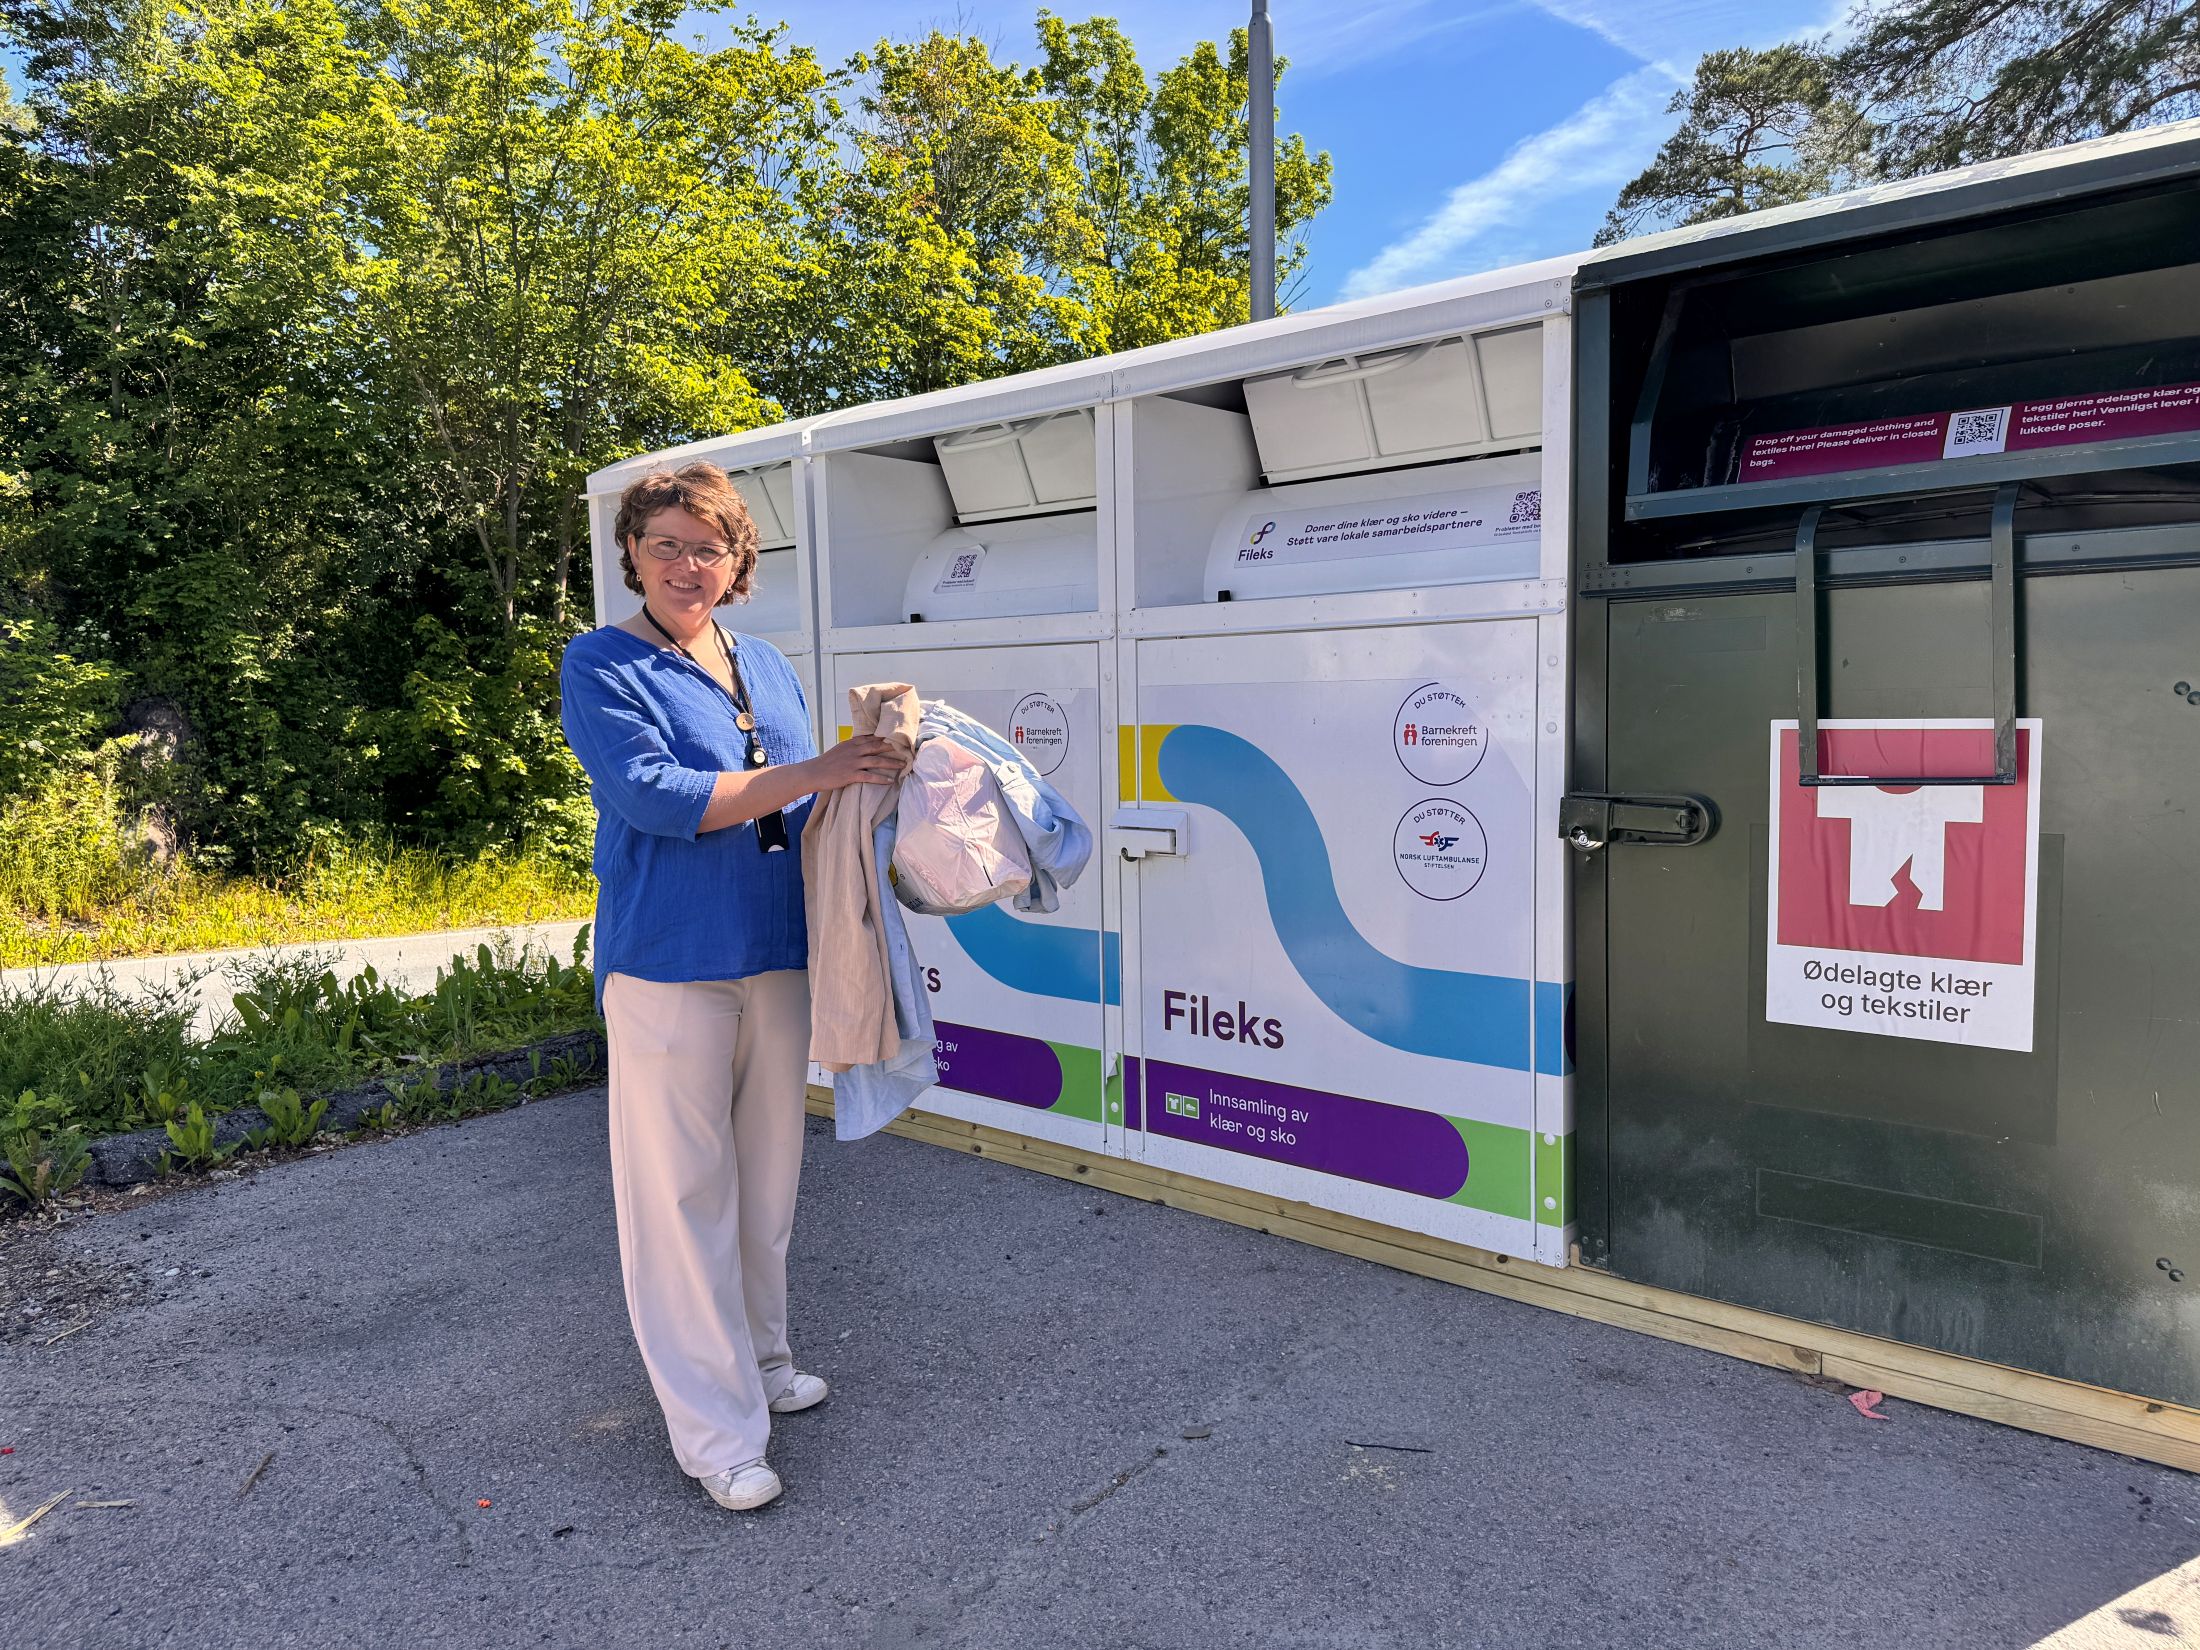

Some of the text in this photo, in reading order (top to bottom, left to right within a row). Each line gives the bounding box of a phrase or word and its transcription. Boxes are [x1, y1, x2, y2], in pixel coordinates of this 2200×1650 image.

[2056, 399, 2094, 410] gjerne
[2096, 392, 2150, 403] ødelagte
[2153, 388, 2182, 398] klær
[2022, 396, 2200, 423] tekstiler her! Vennligst lever i
[1780, 435, 1794, 444] off
[1795, 434, 1818, 443] your
[1820, 427, 1867, 439] damaged
[1870, 422, 1912, 432] clothing
[1914, 418, 1935, 427] and
[2020, 420, 2106, 435] lukkede poser.
[1752, 446, 1787, 456] textiles
[1790, 442, 1815, 452] here!
[1817, 439, 1850, 448] Please
[1852, 435, 1888, 446] deliver
[1902, 428, 1938, 438] closed
[1750, 459, 1776, 467] bags.
[1305, 524, 1335, 533] Doner
[1338, 521, 1358, 530] dine
[1361, 518, 1384, 527] klær
[1402, 513, 1420, 522] sko
[1423, 510, 1457, 520] videre
[1287, 536, 1314, 546] Støtt
[1341, 530, 1370, 541] lokale
[1372, 519, 1482, 538] samarbeidspartnere
[1238, 548, 1273, 561] Fileks
[1021, 701, 1055, 714] DU STØTTER
[1414, 698, 1426, 709] DU
[1026, 727, 1062, 736] Barnekreft
[1422, 725, 1477, 734] Barnekreft
[1026, 736, 1062, 746] foreningen
[1421, 737, 1477, 747] foreningen
[1414, 808, 1465, 824] DU STØTTER
[1423, 855, 1479, 864] LUFTAMBULANSE
[1803, 960, 1992, 997] Ødelagte klær
[1821, 992, 1971, 1023] og tekstiler
[1164, 990, 1284, 1049] Fileks
[946, 1042, 958, 1052] av
[1209, 1088, 1309, 1124] Innsamling av
[1210, 1113, 1296, 1146] klær og sko
